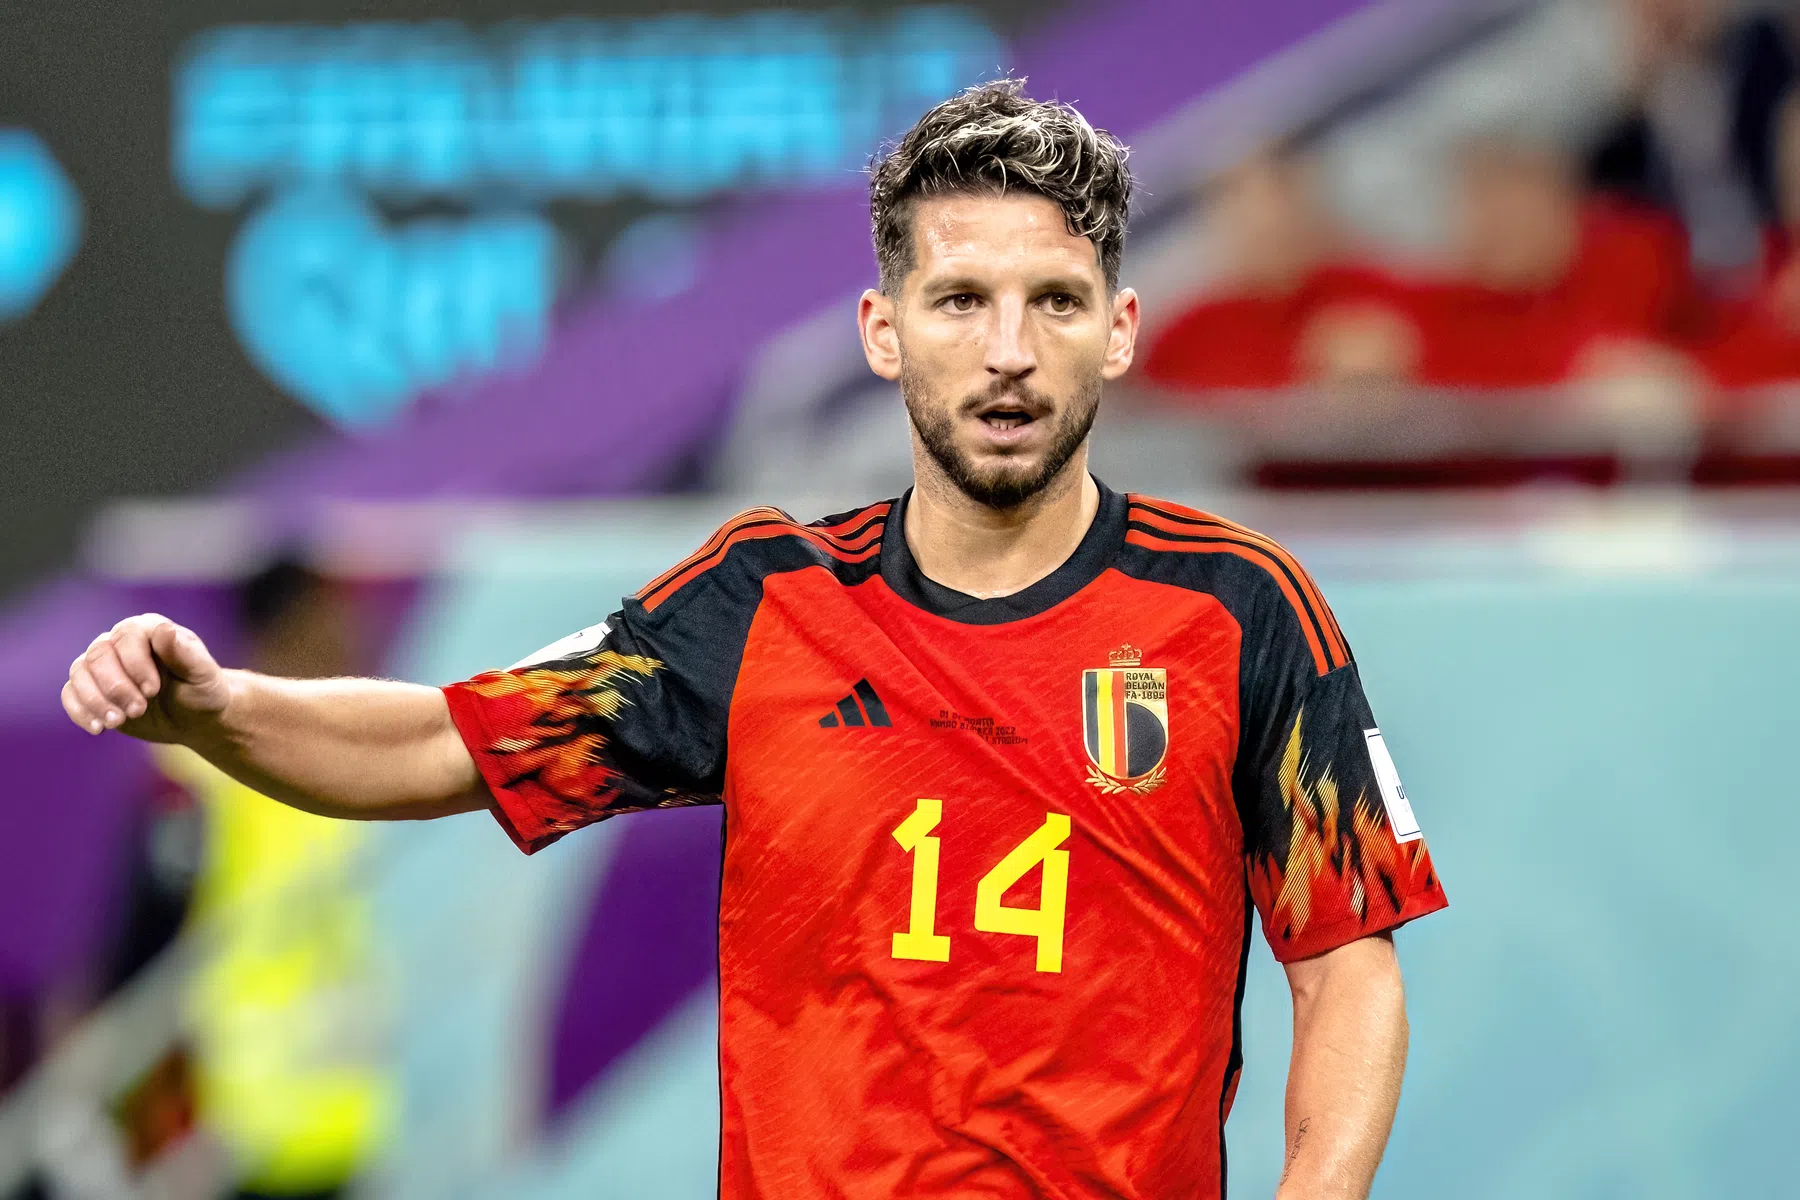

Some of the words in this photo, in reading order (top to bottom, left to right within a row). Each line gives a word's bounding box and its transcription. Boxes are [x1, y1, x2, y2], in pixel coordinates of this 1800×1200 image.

[1126, 672, 1155, 681] ROYAL
[1125, 681, 1165, 690] BELGIAN
[891, 798, 1072, 974] 14
